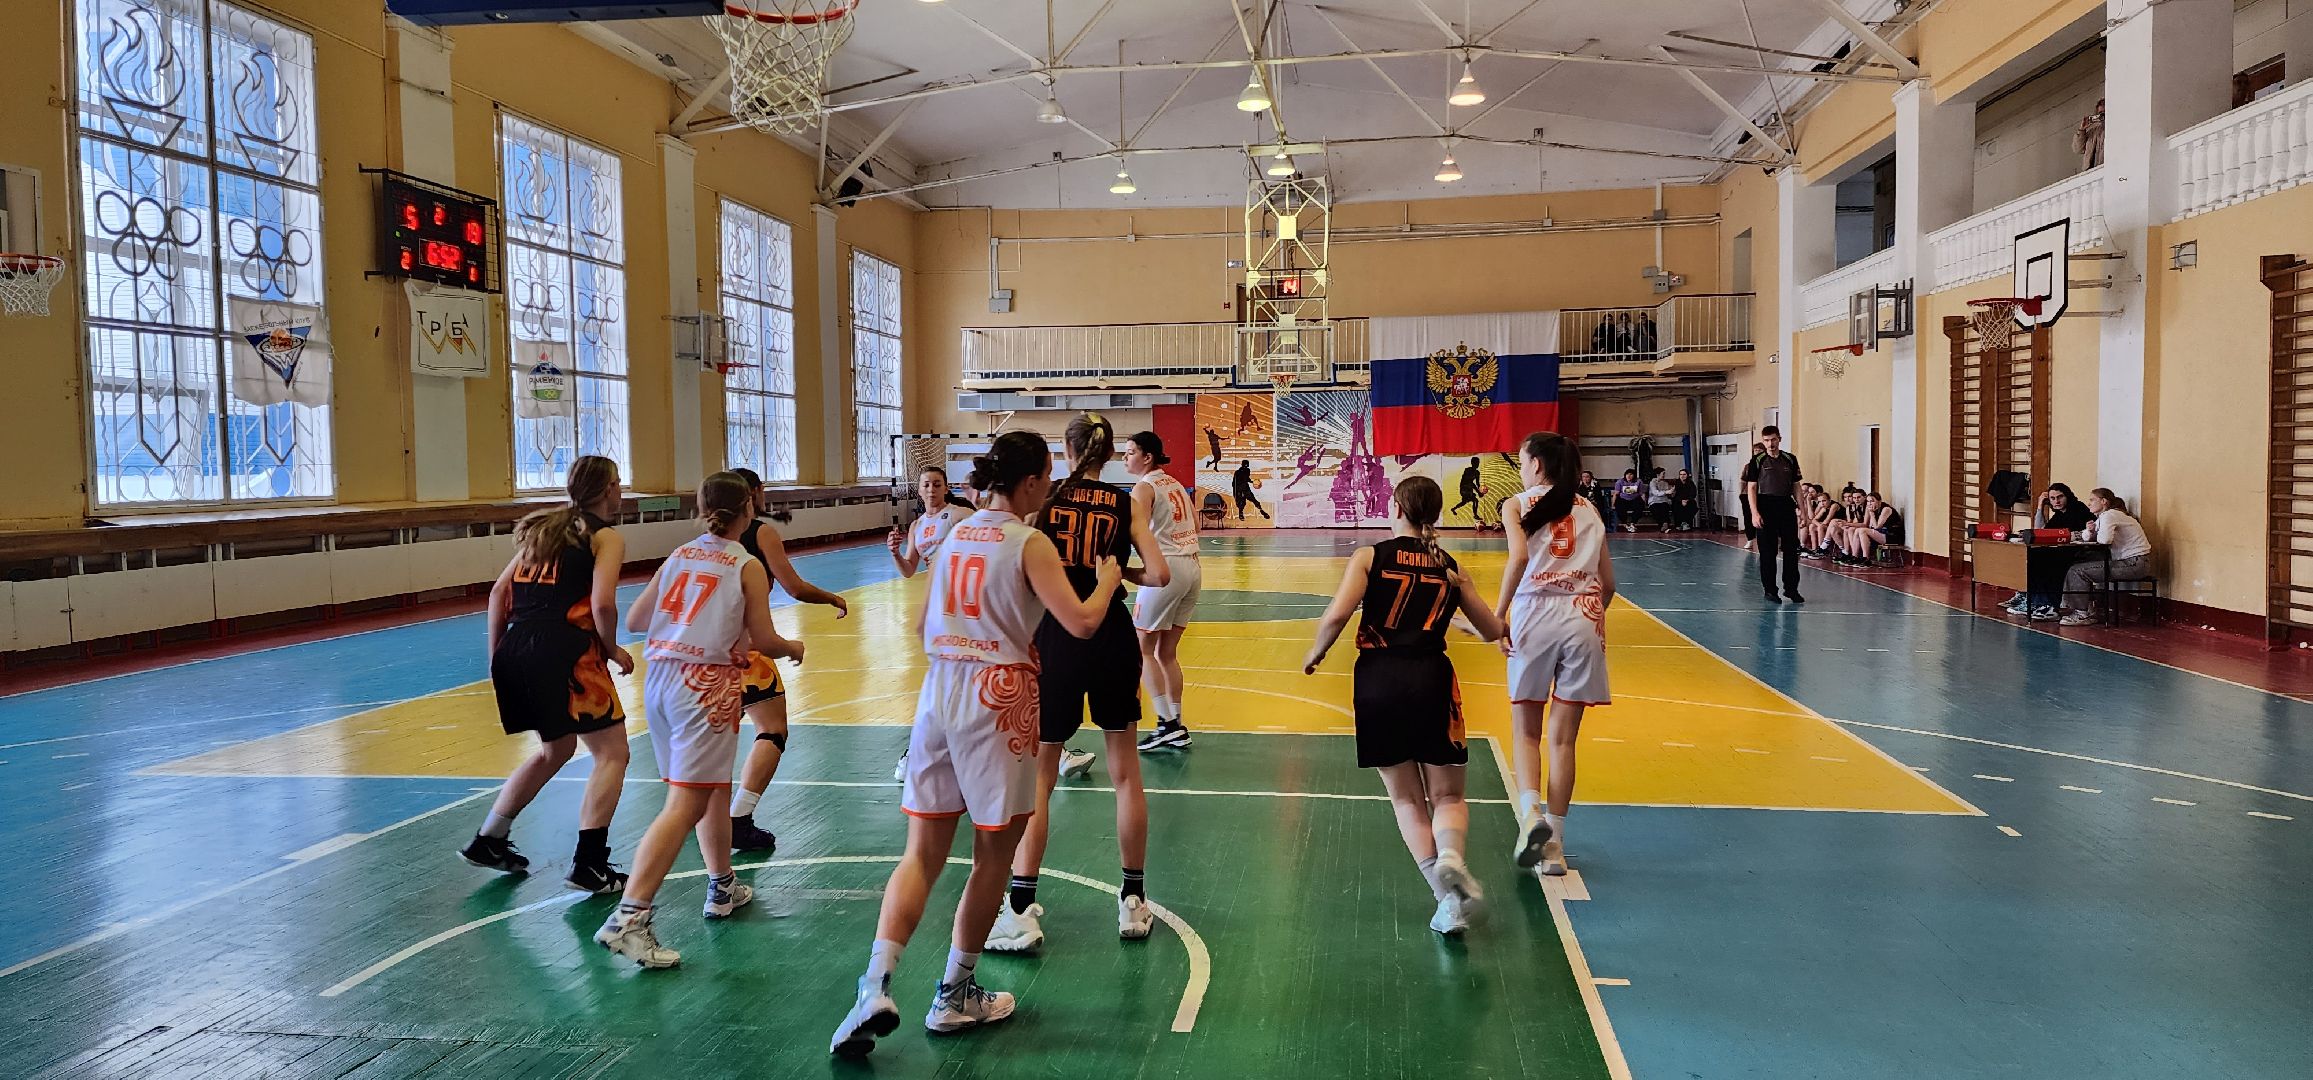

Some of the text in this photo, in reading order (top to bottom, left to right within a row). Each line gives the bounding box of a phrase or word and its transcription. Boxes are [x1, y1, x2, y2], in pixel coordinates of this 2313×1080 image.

[406, 204, 418, 230] 5
[433, 206, 445, 226] 2
[1060, 485, 1117, 508] ЕДВЕДЕВА
[1049, 505, 1119, 569] 30
[1396, 549, 1443, 568] ОСОКИН
[1549, 513, 1577, 560] 9
[658, 569, 723, 627] 47
[943, 551, 988, 621] 10
[1381, 569, 1452, 631] 77
